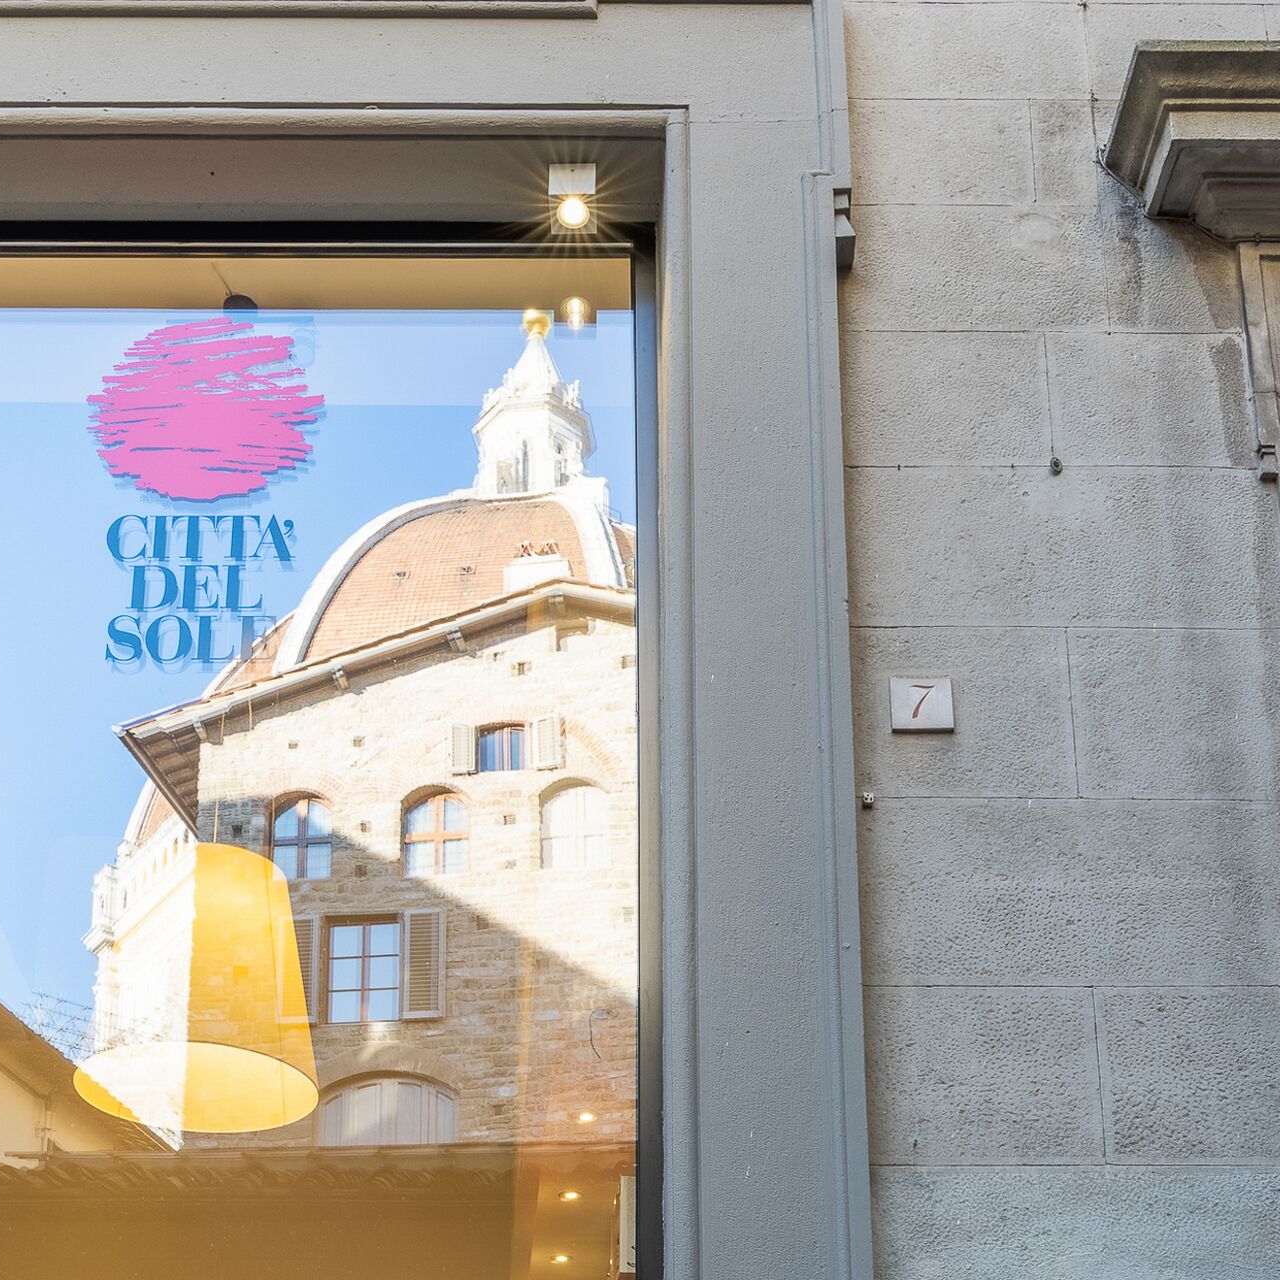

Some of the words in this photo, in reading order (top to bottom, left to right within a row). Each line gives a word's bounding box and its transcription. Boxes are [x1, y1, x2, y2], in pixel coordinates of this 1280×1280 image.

[106, 514, 295, 562] CITTA'
[125, 564, 263, 612] DEL
[105, 615, 278, 663] SOLE
[910, 684, 935, 719] 7
